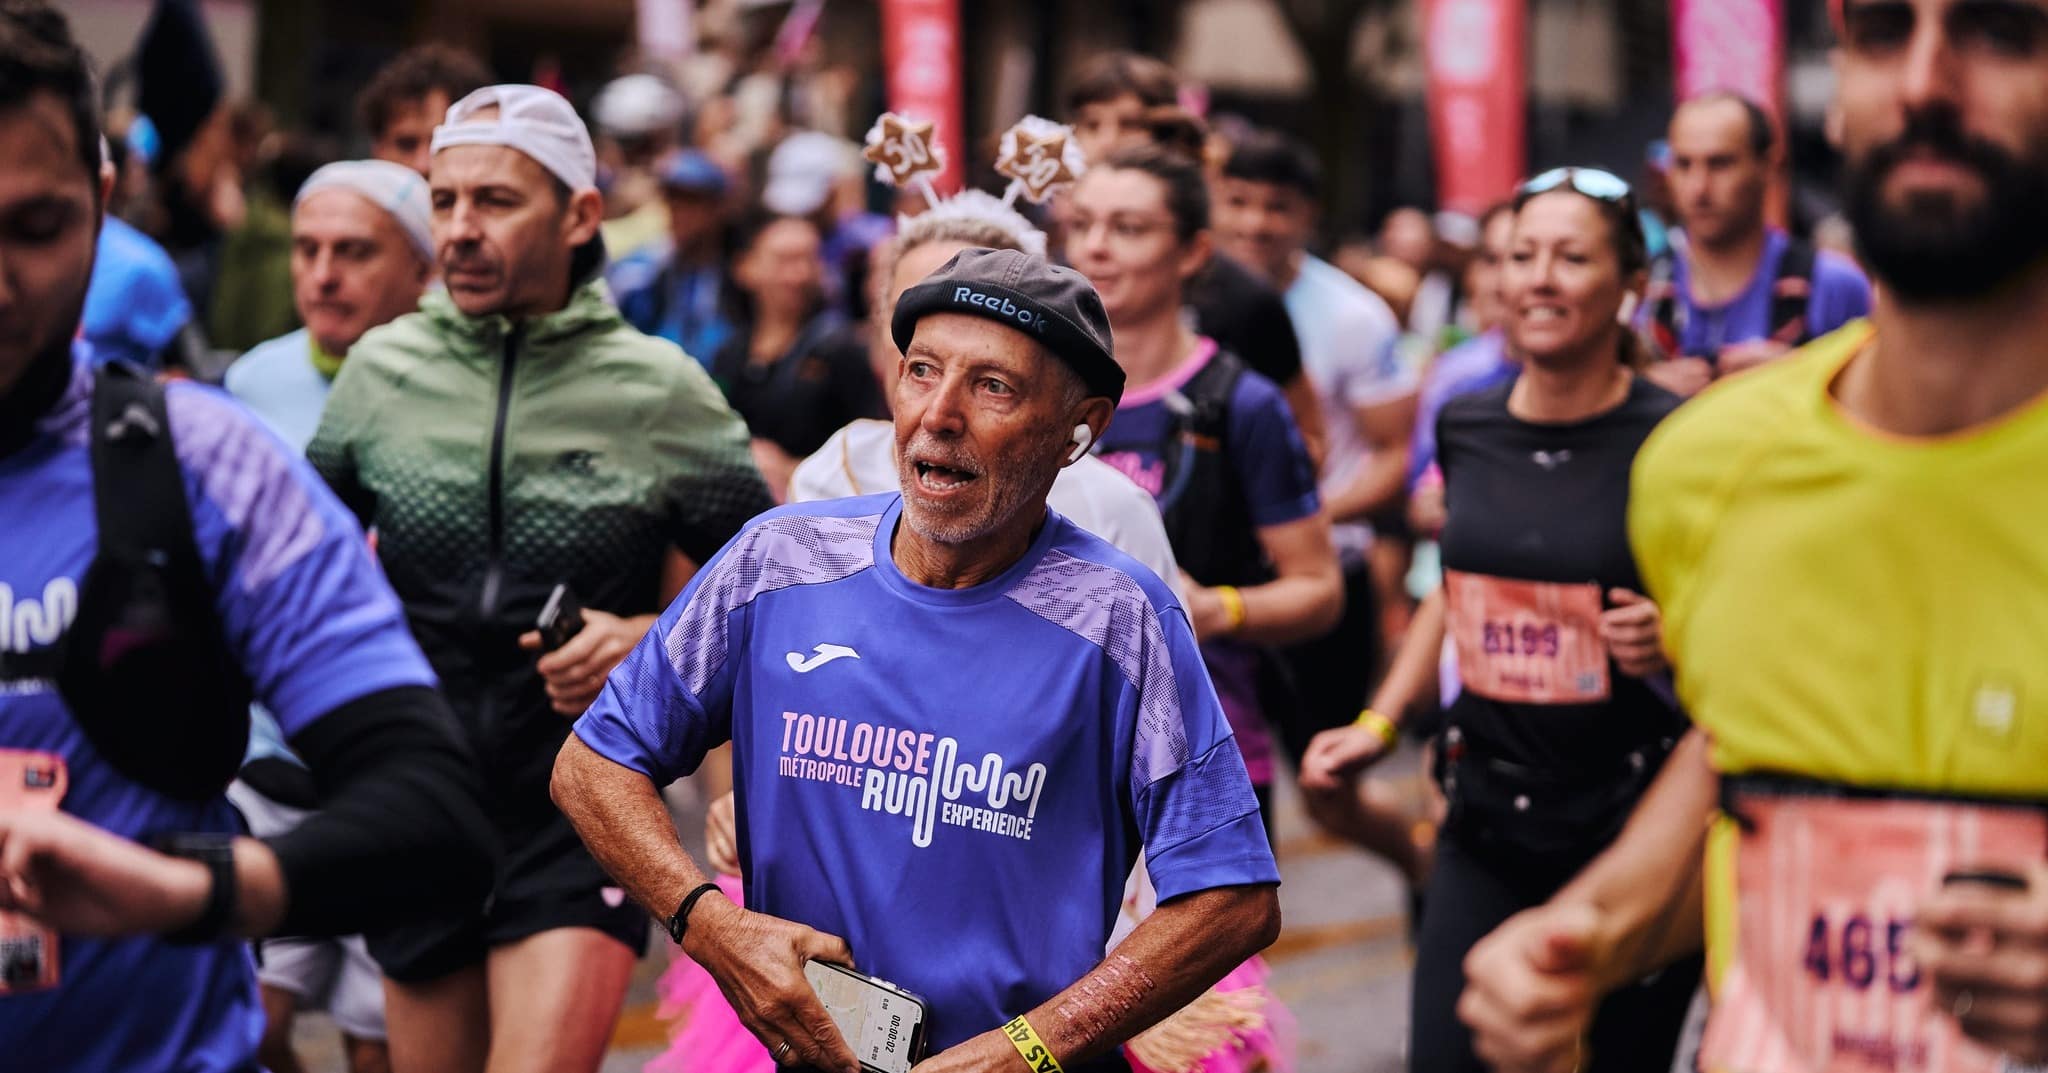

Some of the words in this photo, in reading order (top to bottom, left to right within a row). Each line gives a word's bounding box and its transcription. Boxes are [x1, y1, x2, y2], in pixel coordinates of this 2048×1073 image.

[954, 287, 1047, 333] Reebok
[782, 711, 934, 775] TOULOUSE
[779, 754, 864, 788] MÉTROPOLE
[861, 768, 932, 847] RUN
[942, 802, 1034, 840] EXPERIENCE
[885, 1014, 901, 1054] 00:00:02
[1025, 1044, 1062, 1073] AS
